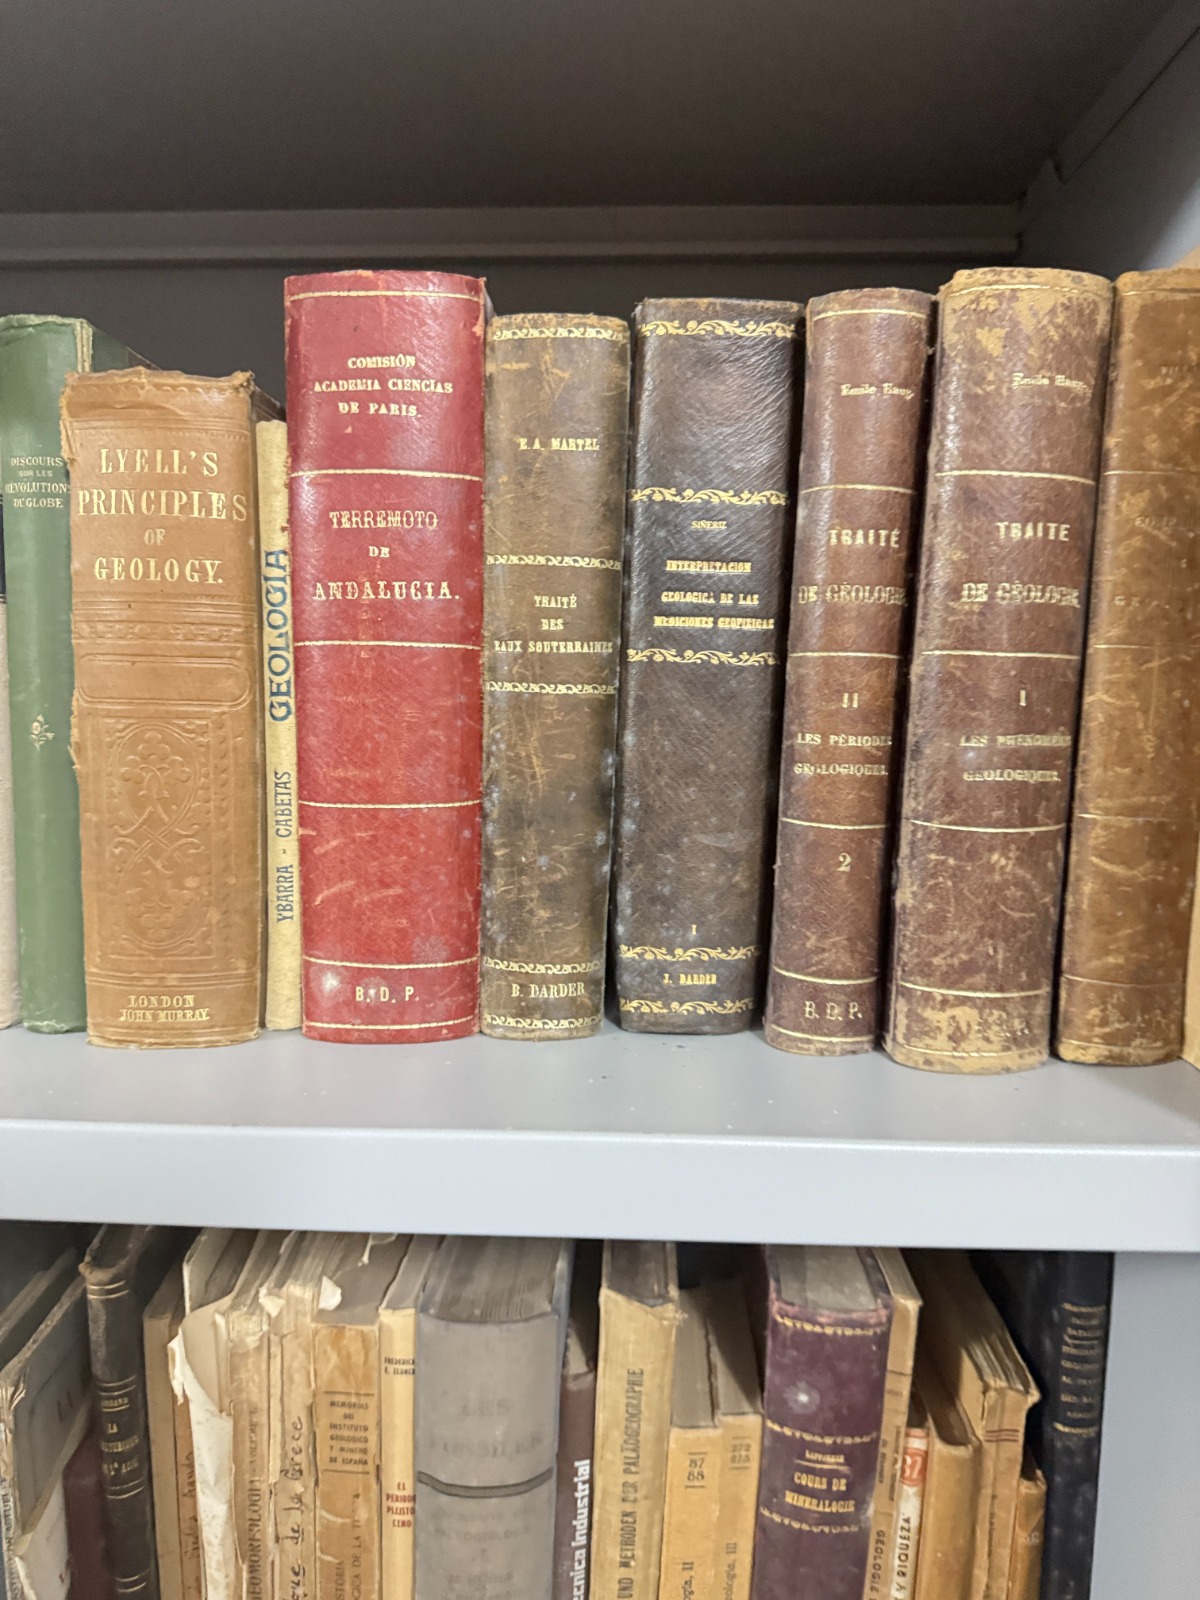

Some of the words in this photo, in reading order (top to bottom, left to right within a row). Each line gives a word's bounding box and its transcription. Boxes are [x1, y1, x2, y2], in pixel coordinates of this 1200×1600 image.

[314, 379, 381, 392] ACADEMIA
[388, 379, 453, 394] CIENCIAS
[338, 402, 360, 414] DE
[10, 456, 63, 466] DISCOURS
[100, 449, 219, 476] LYELL'S
[77, 489, 247, 521] PRINCIPLES
[329, 510, 439, 528] TERREMOTO
[144, 529, 166, 545] OF
[368, 546, 390, 558] DE
[94, 557, 224, 584] GEOLOGY.
[720, 593, 733, 604] DE
[738, 594, 759, 605] LAS
[798, 585, 818, 603] DE
[960, 583, 988, 602] DE
[541, 618, 564, 630] DES
[494, 641, 522, 652] EAUX
[797, 732, 821, 744] LES
[274, 769, 293, 839] CABETAS
[836, 853, 852, 872] 2
[276, 864, 294, 923] YBARRA
[511, 984, 523, 998] B.
[530, 982, 585, 998] DARDER
[128, 995, 195, 1007] LONDON
[119, 1009, 153, 1021] JOHN
[158, 1008, 210, 1022] MURRAY
[329, 1422, 368, 1432] INSTITUTO
[689, 1457, 704, 1468] 87
[687, 1470, 704, 1481] 88
[794, 1472, 827, 1489] COURS
[571, 1459, 590, 1547] Industrial
[896, 1516, 912, 1578] RIQUEZA
